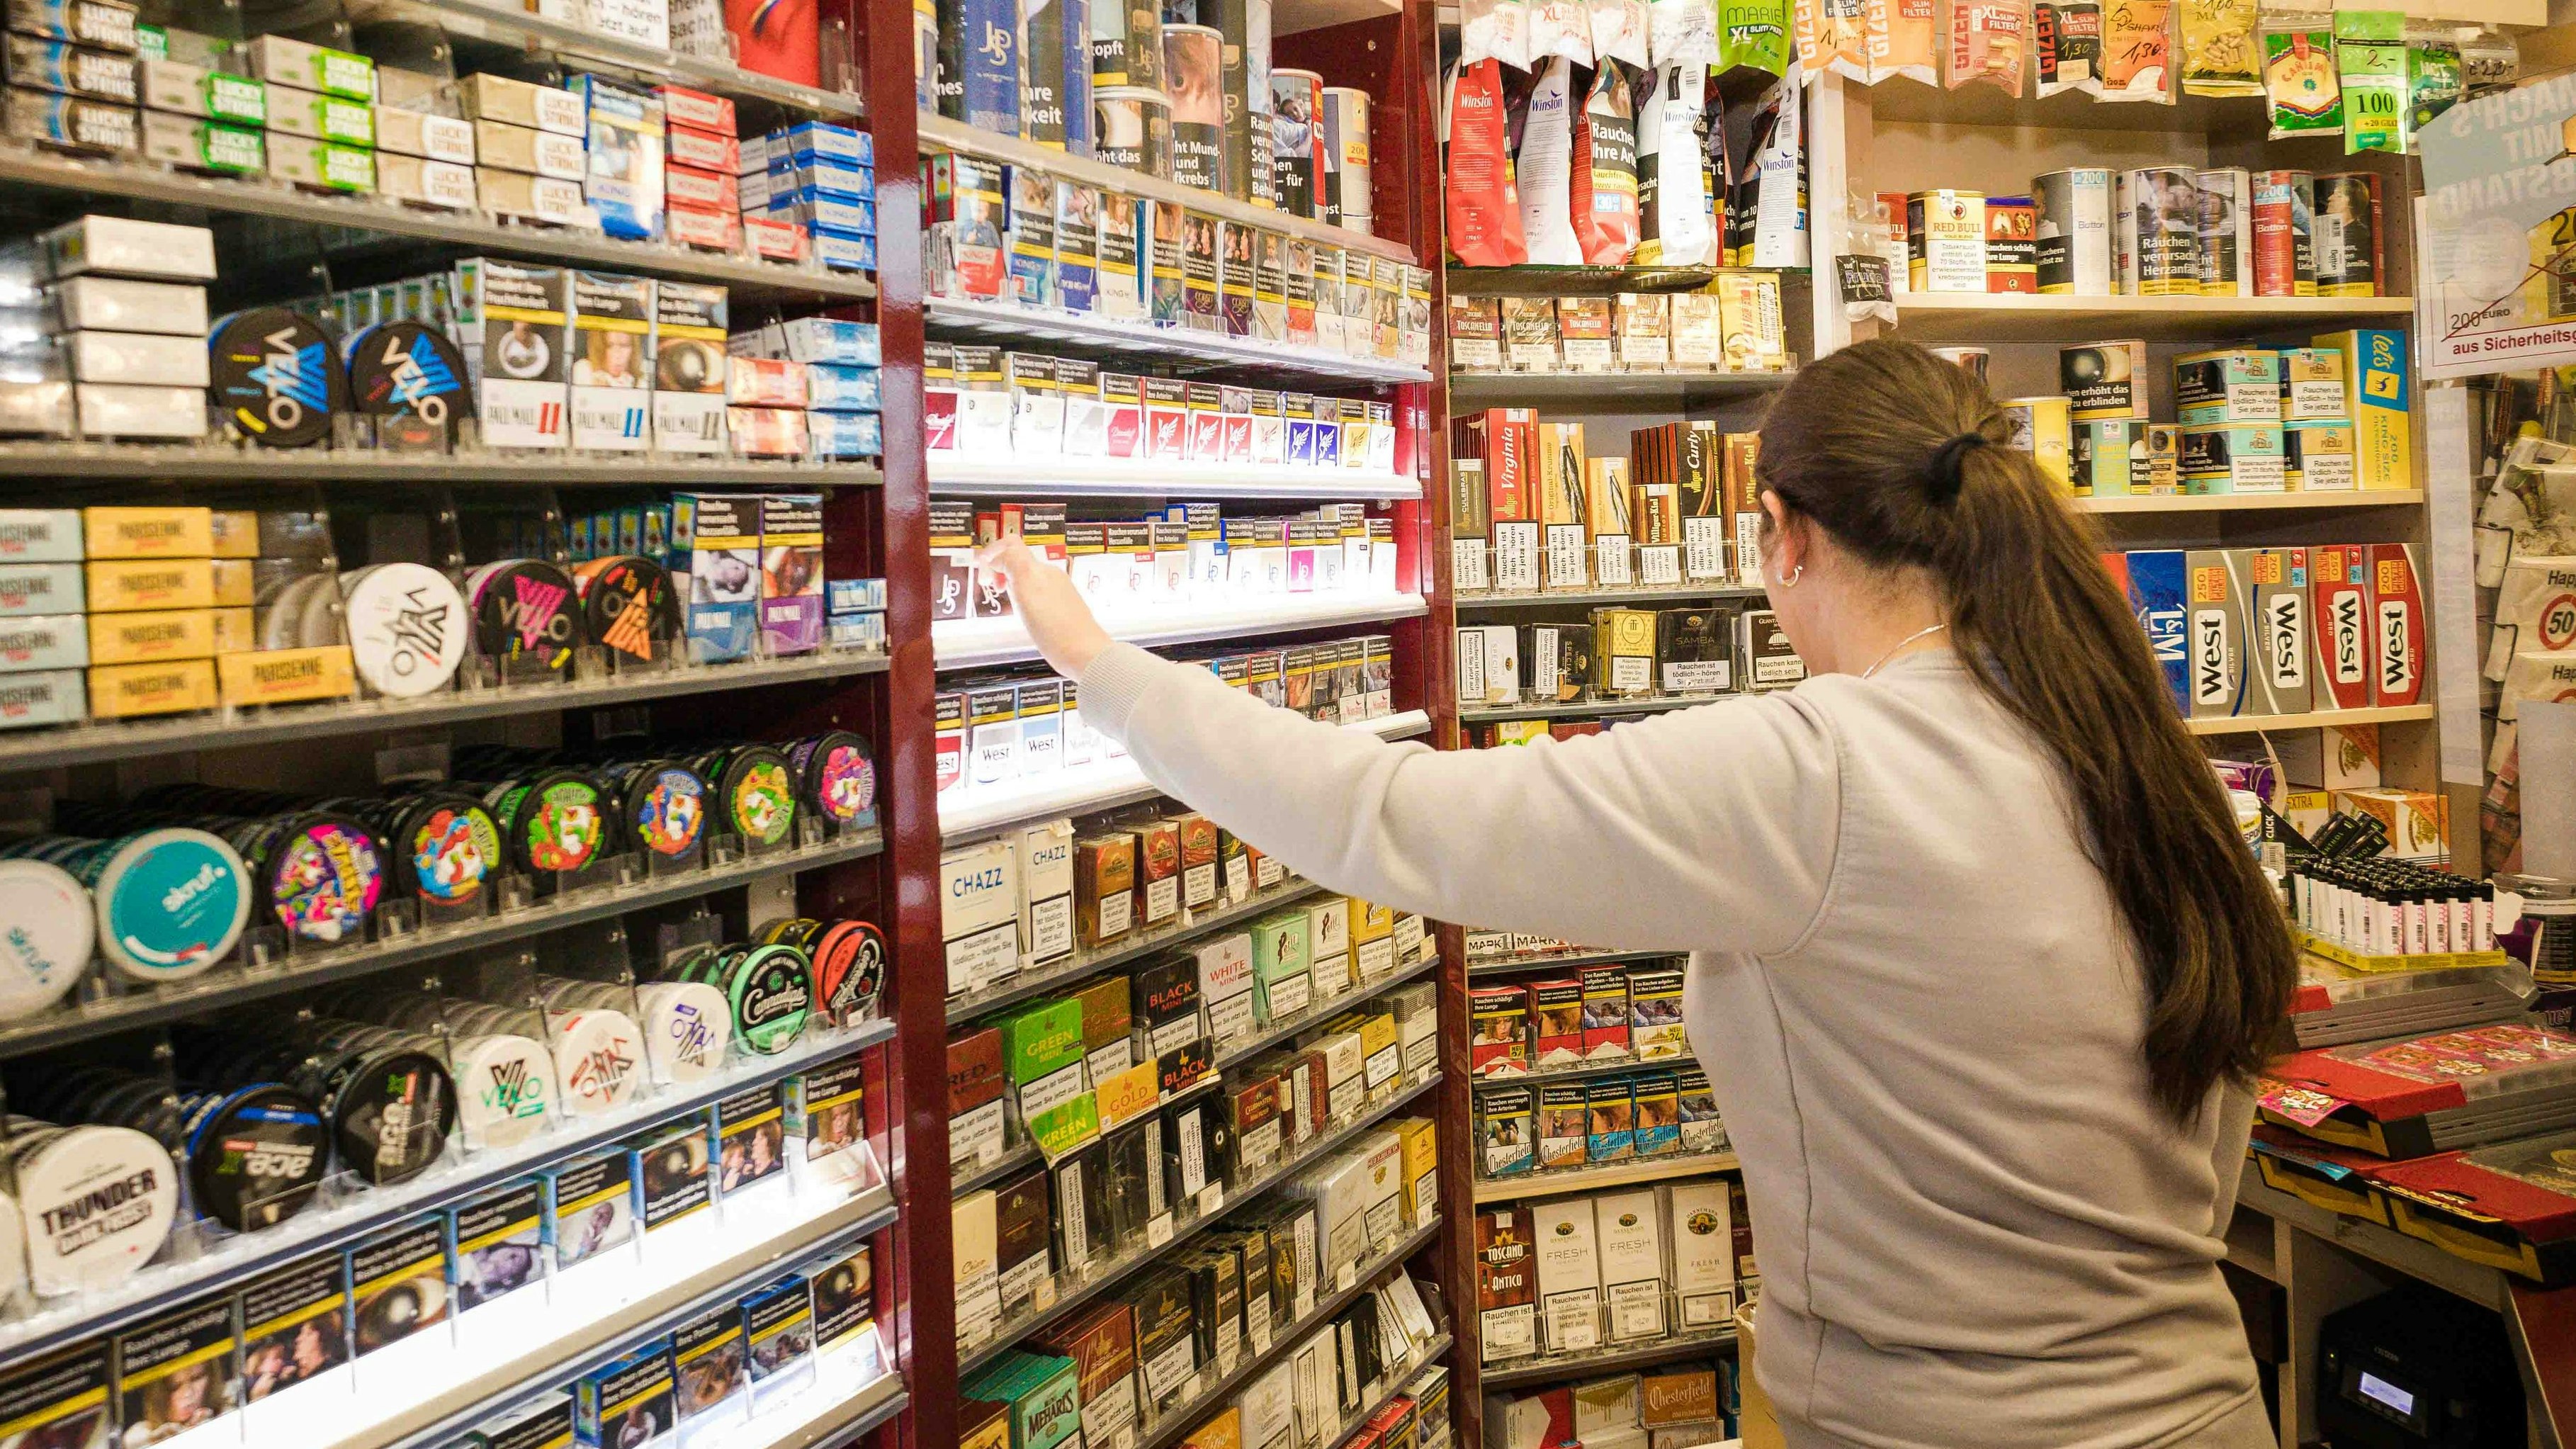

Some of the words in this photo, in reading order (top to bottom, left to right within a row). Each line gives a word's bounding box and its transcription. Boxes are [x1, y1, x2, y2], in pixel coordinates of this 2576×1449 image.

[1727, 7, 1784, 23] MARIE
[1904, 8, 1931, 16] FILTER
[1982, 6, 2001, 19] XL
[2059, 11, 2079, 24] XL
[1989, 21, 2016, 30] FILTER
[2069, 24, 2097, 33] FILTER
[1730, 28, 1752, 43] XL
[1955, 6, 1970, 69] GIZEH
[2036, 9, 2056, 74] GIZEH
[1461, 94, 1493, 108] Winston
[1532, 98, 1562, 112] Winston
[2356, 94, 2394, 114] 100
[1119, 151, 1140, 162] das
[1763, 157, 1794, 171] Winston
[1287, 176, 1302, 186] für
[2081, 173, 2101, 183] 200
[1933, 222, 1955, 232] RED
[1958, 222, 1982, 232] BULL
[2143, 237, 2190, 248] Rauchen
[1999, 253, 2019, 262] Lunge
[2451, 312, 2480, 329] 200
[2482, 309, 2510, 319] EURO
[2453, 343, 2478, 354] aus
[2081, 386, 2111, 396] erhöht
[2113, 385, 2128, 394] das
[2083, 396, 2125, 406] erblinden
[2233, 397, 2256, 405] tödlich
[2250, 406, 2264, 415] jetzt
[1687, 431, 1700, 468] Curly
[1501, 427, 1515, 490] Virginia
[2198, 574, 2207, 599] 250
[2381, 568, 2390, 591] 200
[2548, 611, 2574, 633] 50
[2149, 604, 2185, 661] L&M
[2276, 599, 2296, 680] West
[2338, 597, 2356, 675] West
[2385, 609, 2403, 687] West
[2201, 618, 2221, 697] West
[1029, 738, 1054, 751] West
[983, 748, 1009, 760] West
[2266, 814, 2274, 839] CLICK
[1033, 845, 1066, 865] CHAZZ
[953, 867, 1002, 896] CHAZZ
[963, 935, 990, 949] Rauchen
[1210, 959, 1246, 981] WHITE
[1219, 976, 1238, 987] MINI
[1150, 981, 1192, 1009] BLACK
[1027, 1030, 1073, 1057] GREEN
[1165, 1059, 1207, 1087] BLACK
[1109, 1086, 1148, 1113] GOLD
[1042, 1119, 1087, 1149] GREEN
[1488, 1143, 1532, 1174] Chesterfield
[1540, 1136, 1586, 1165] Chesterfield
[41, 1168, 156, 1234] THUNDER
[1488, 1244, 1523, 1261] TOSCANO
[1610, 1239, 1650, 1251] FRESH
[1547, 1248, 1588, 1261] FRESH
[1492, 1275, 1522, 1291] ANTICO
[1615, 1286, 1643, 1295] Rauchen
[1552, 1295, 1581, 1304] Rauchen
[1485, 1309, 1518, 1321] Rauchen
[1520, 1307, 1530, 1316] ist
[1649, 1377, 1711, 1409] Chesterfield
